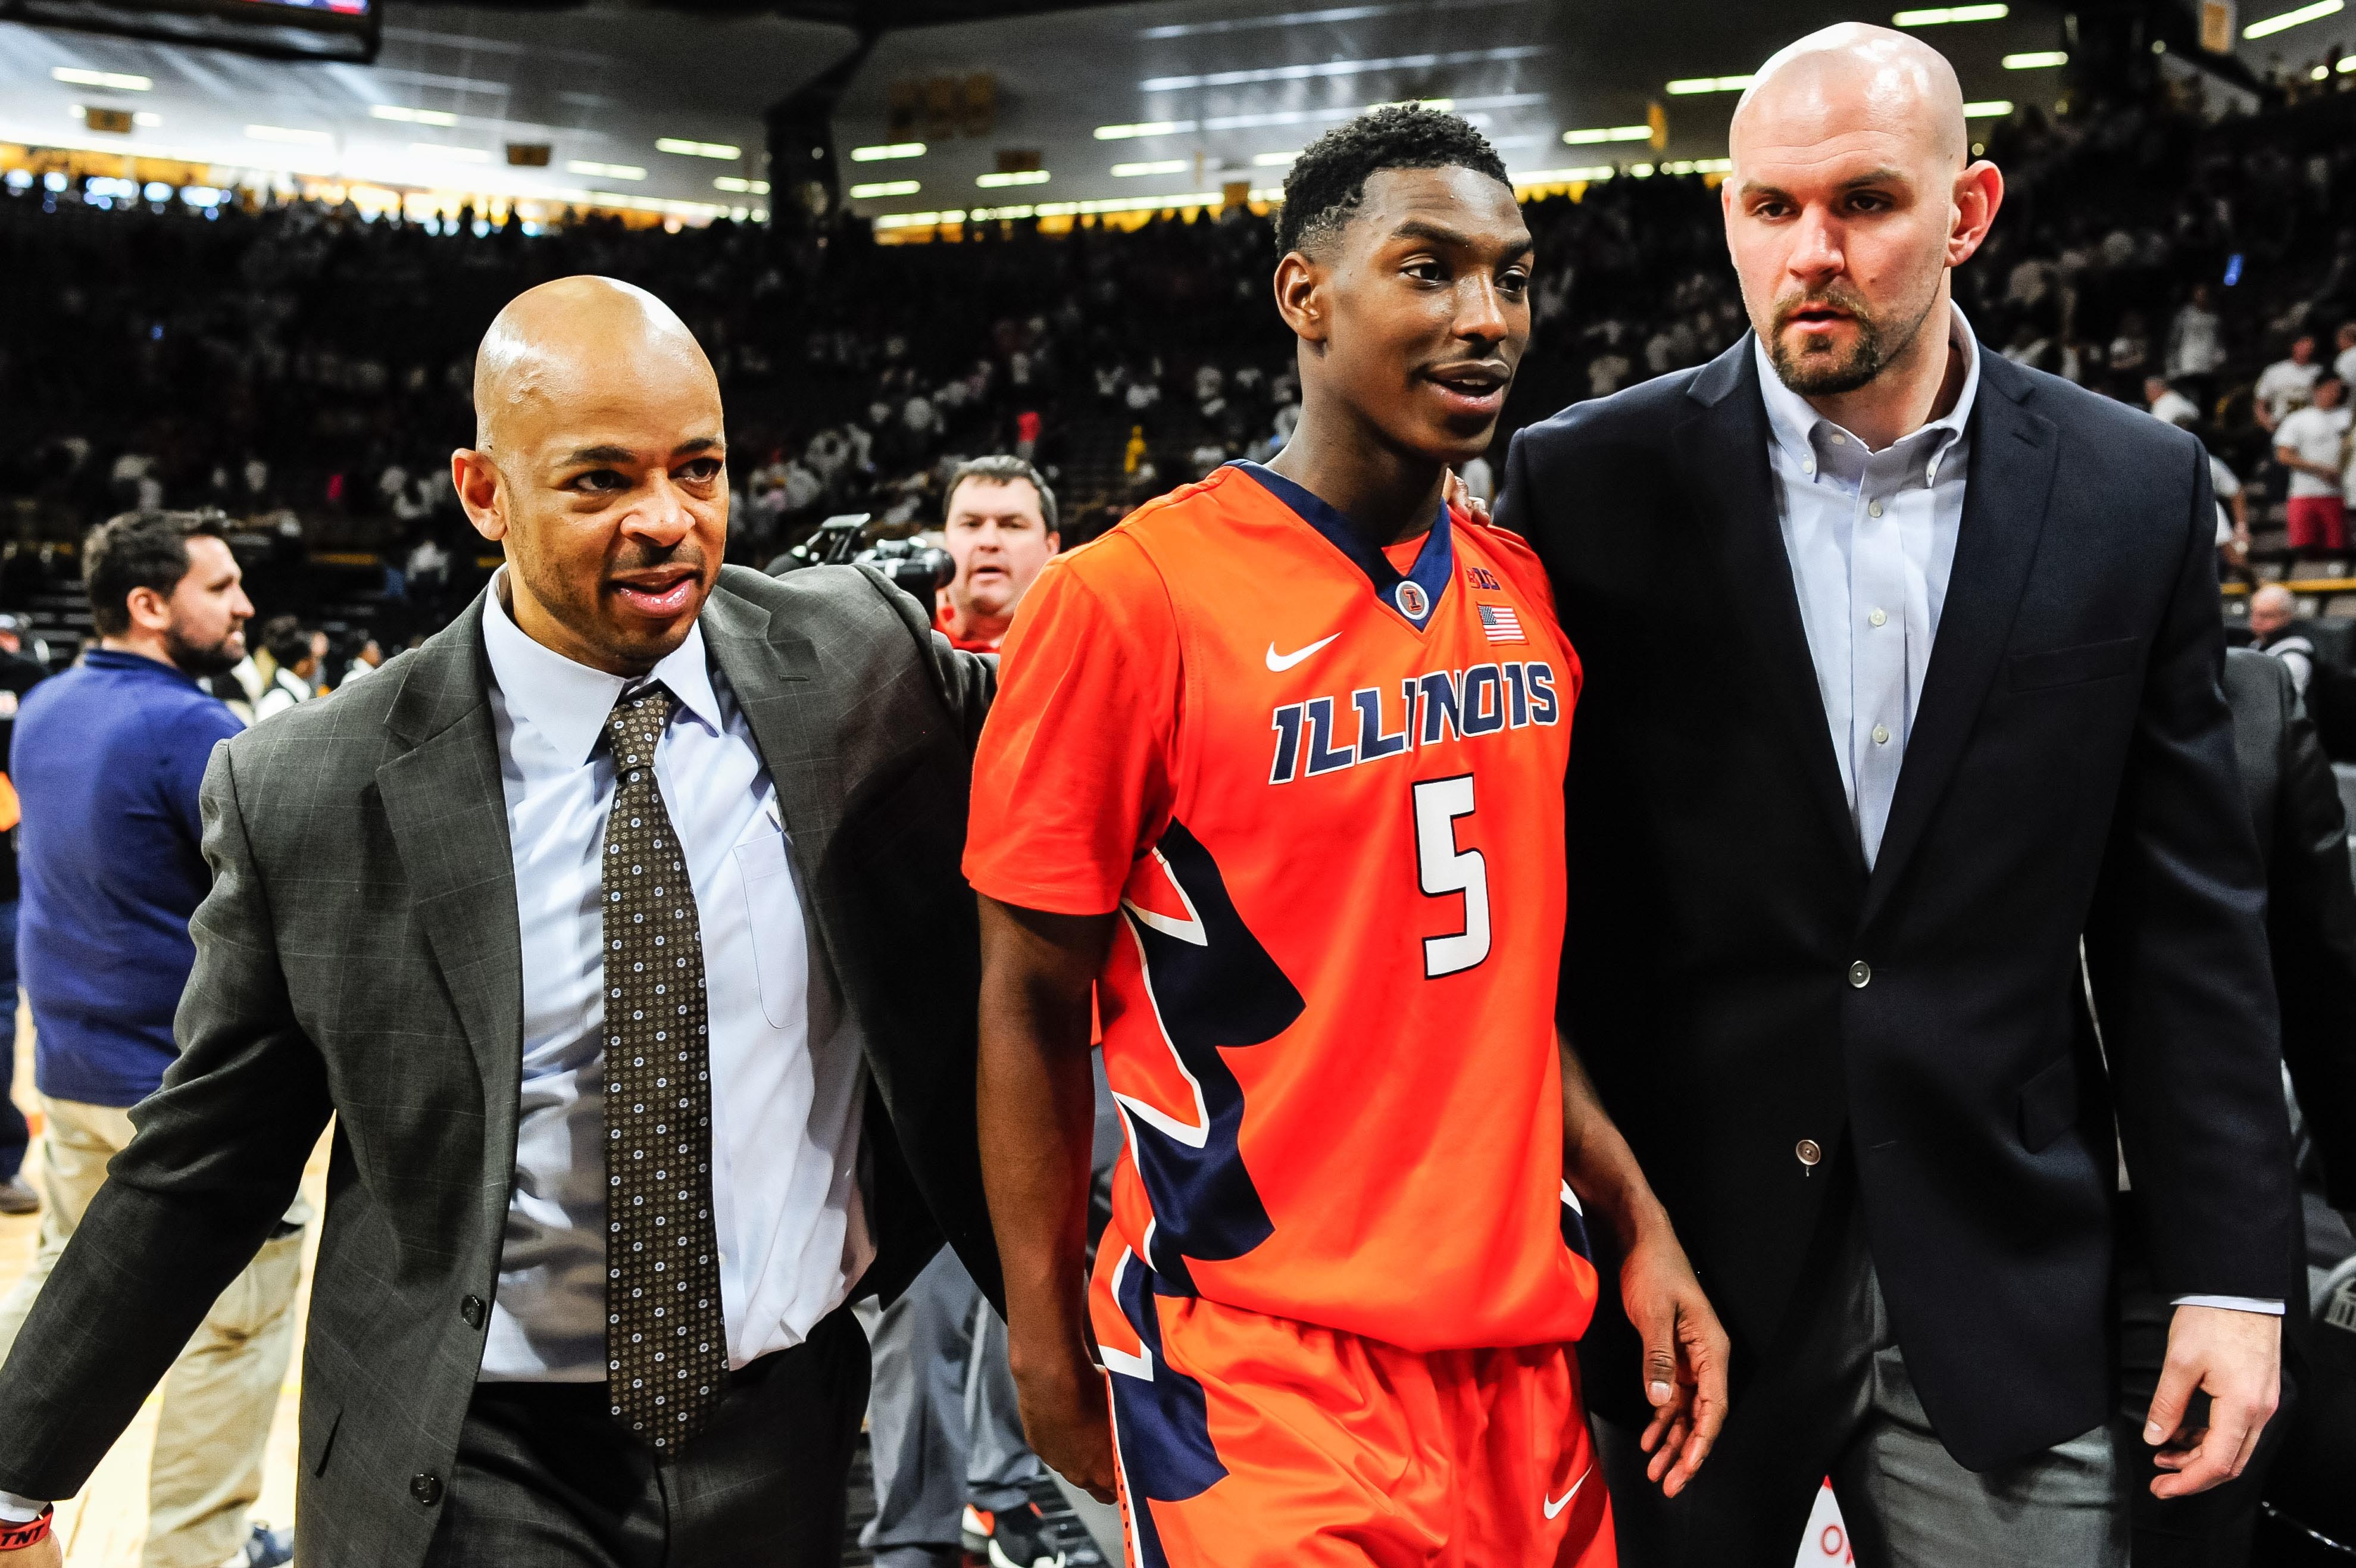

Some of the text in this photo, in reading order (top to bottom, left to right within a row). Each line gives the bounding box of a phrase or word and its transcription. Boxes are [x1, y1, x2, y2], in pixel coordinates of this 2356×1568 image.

[1402, 588, 1421, 611] I
[1268, 661, 1559, 785] ILLINOIS
[1411, 772, 1491, 980] 5
[1, 1523, 45, 1547] TNT
